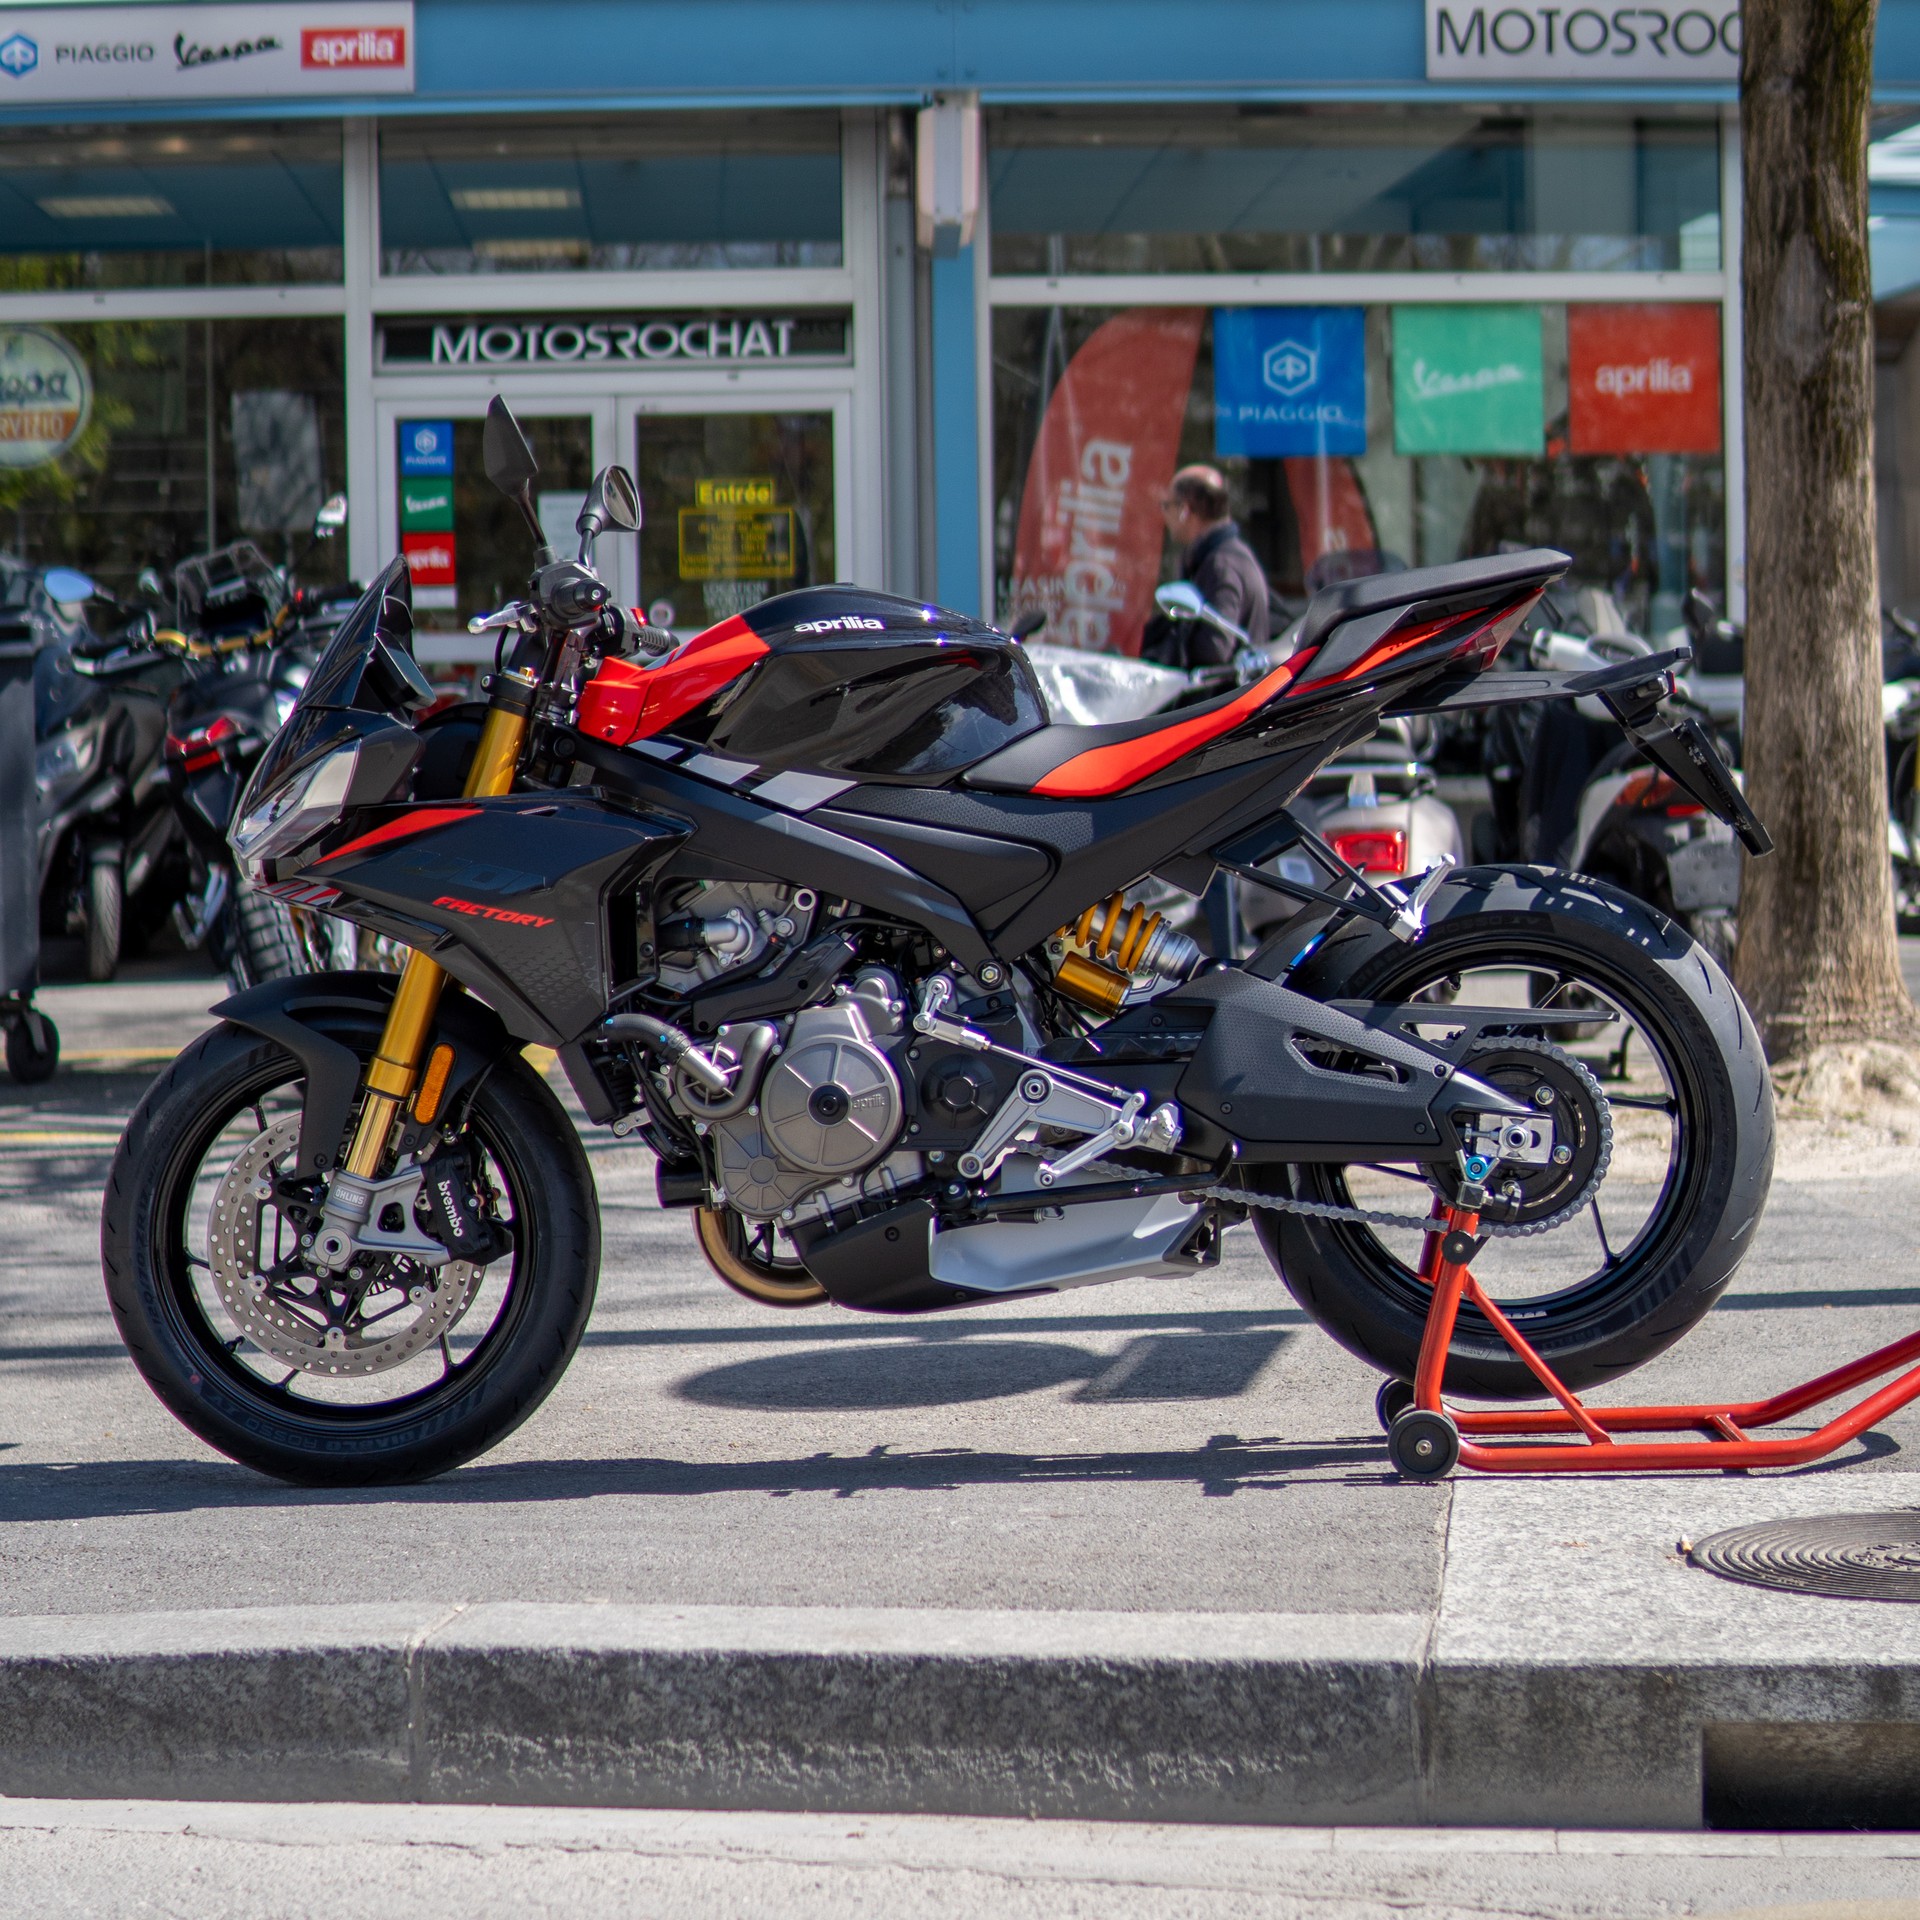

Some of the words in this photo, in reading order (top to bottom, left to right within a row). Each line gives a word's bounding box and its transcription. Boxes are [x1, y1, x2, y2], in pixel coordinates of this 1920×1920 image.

[55, 45, 155, 63] PIAGGIO
[174, 31, 281, 71] Vespa
[311, 32, 394, 66] aprilia
[431, 320, 794, 364] MOTOSROCHAT
[1413, 358, 1523, 398] Vespa
[1595, 359, 1692, 397] aprilia
[1239, 405, 1342, 422] PIAGGIO
[700, 481, 770, 505] Entrée
[1057, 438, 1133, 651] aprilia
[794, 616, 885, 633] aprilia
[431, 895, 554, 929] FACTORY
[853, 1092, 885, 1109] aprilia
[437, 1180, 465, 1238] brembo
[246, 1418, 318, 1450] ROSSO
[326, 1430, 414, 1451] DIABLO
